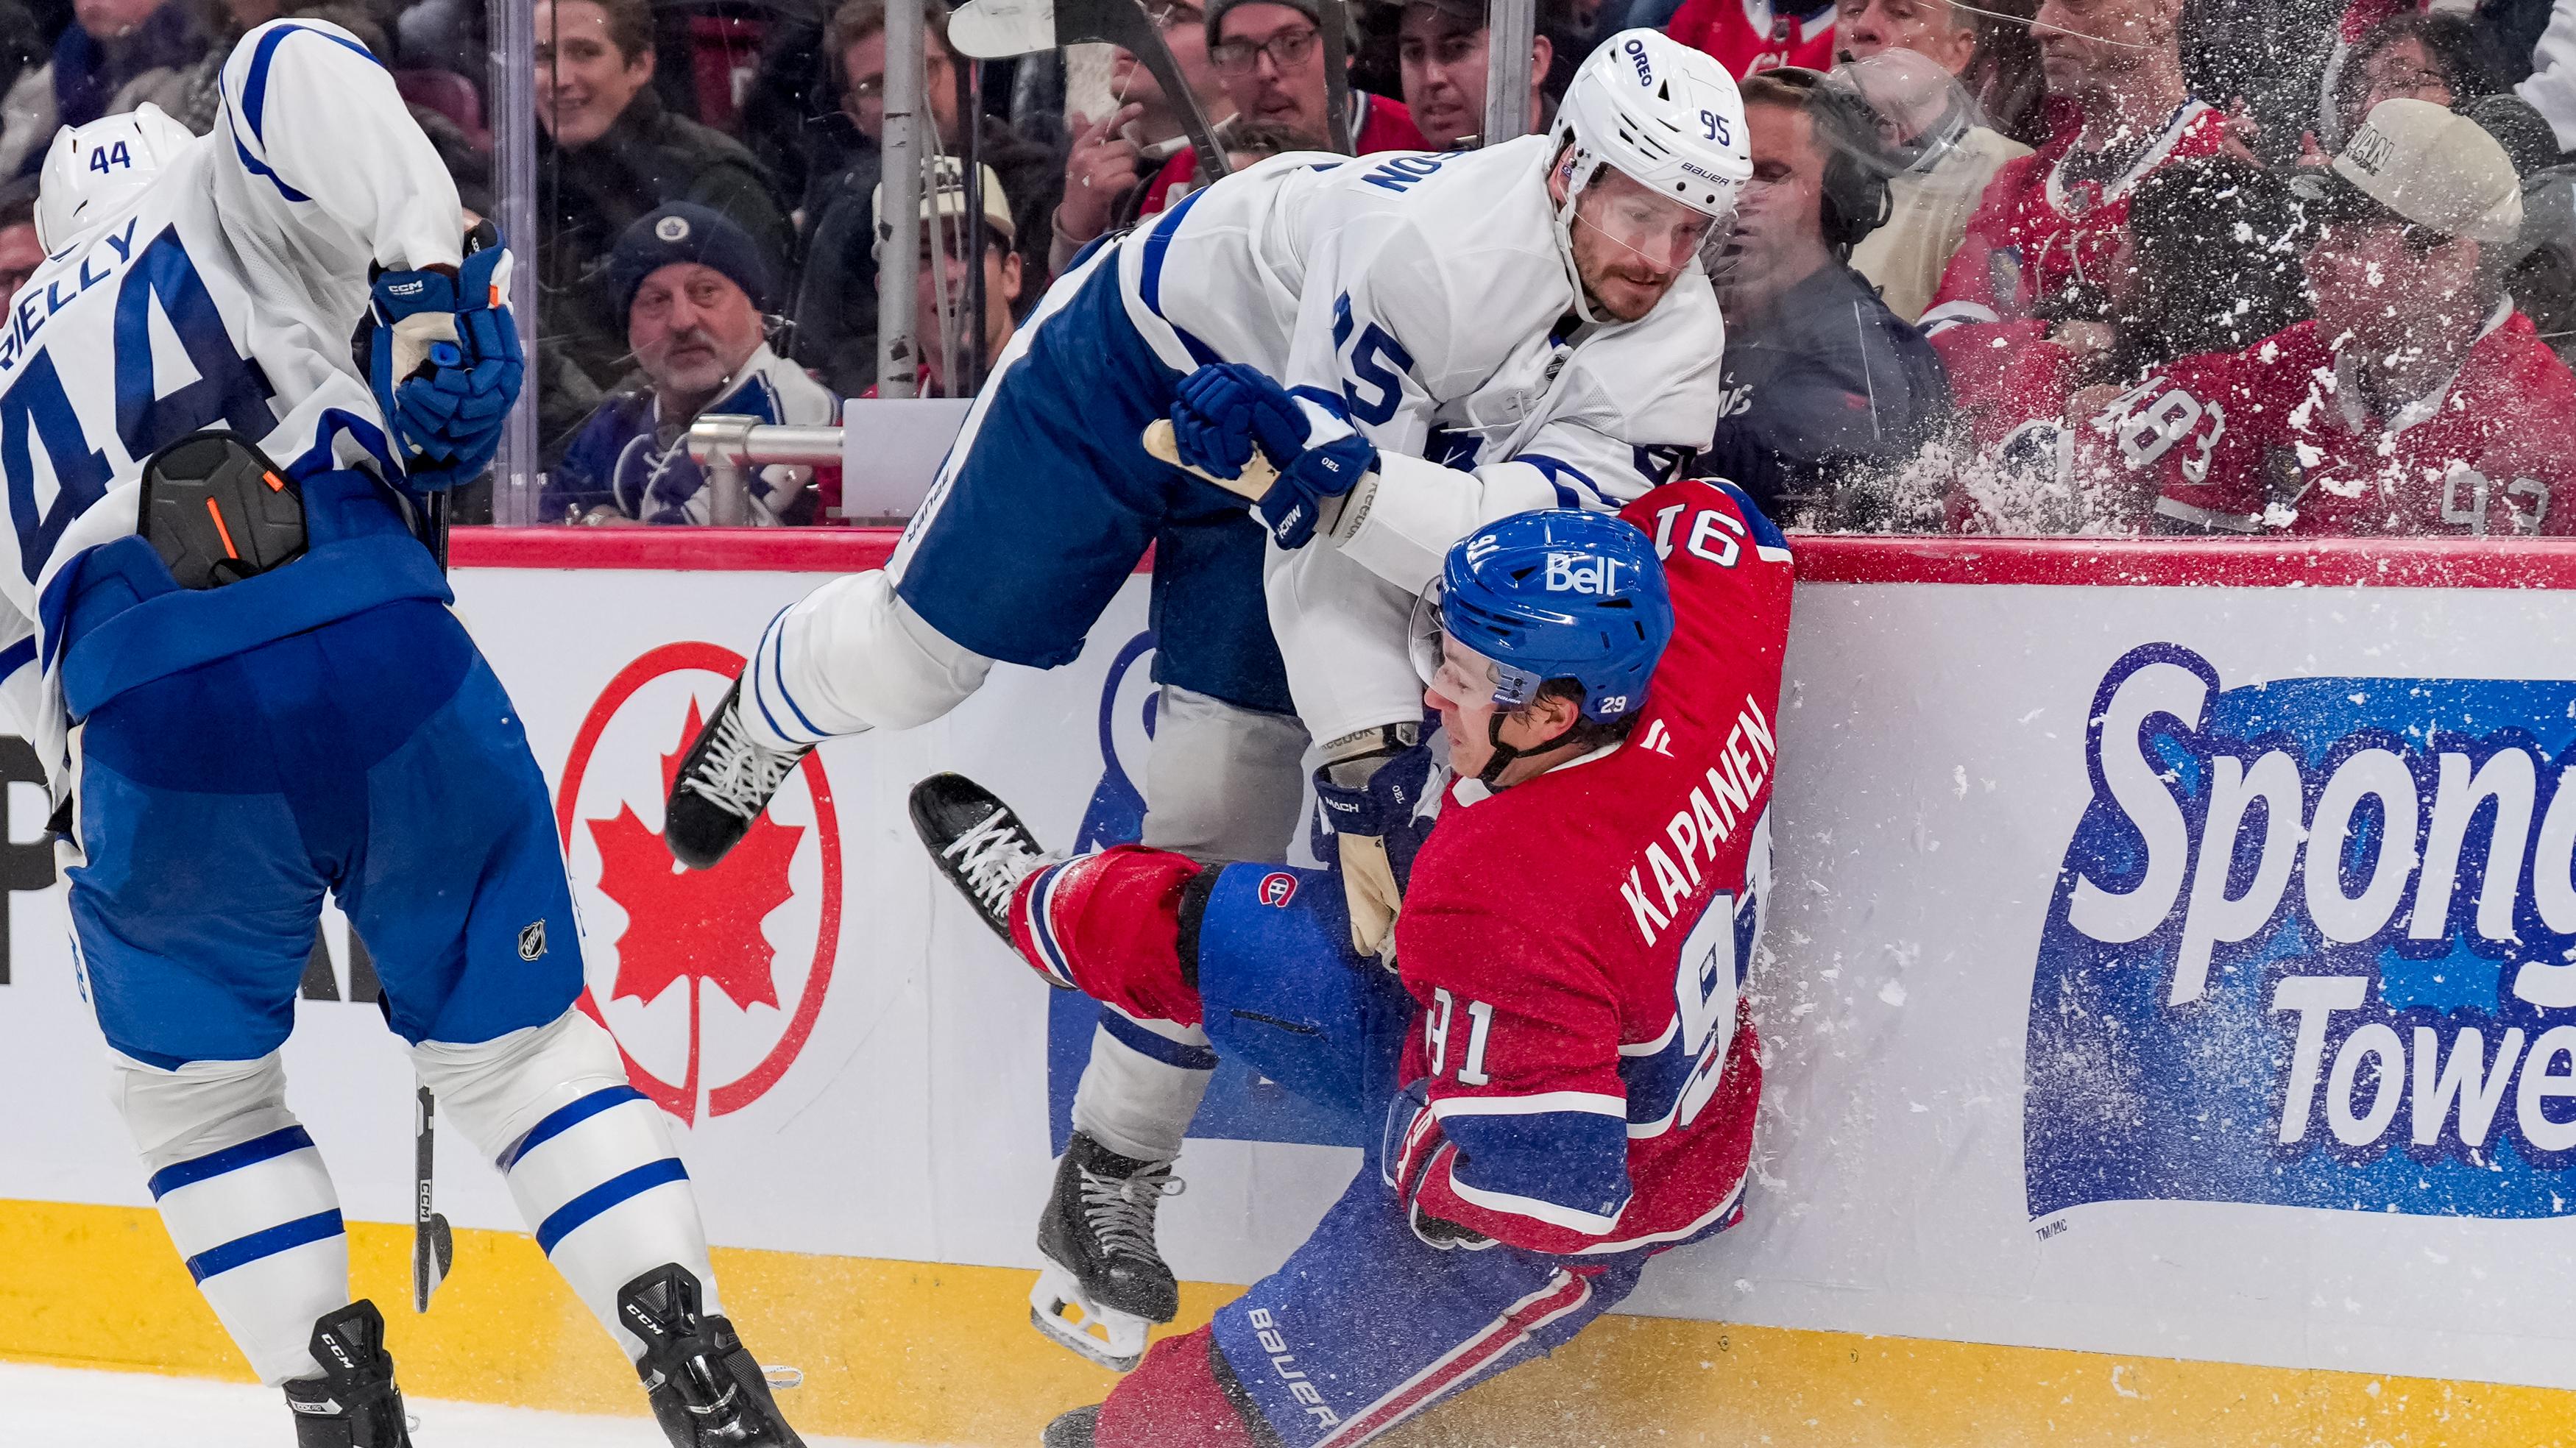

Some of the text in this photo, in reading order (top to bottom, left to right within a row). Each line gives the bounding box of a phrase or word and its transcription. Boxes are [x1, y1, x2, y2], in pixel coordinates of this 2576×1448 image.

[1624, 39, 1652, 87] OREO
[1700, 110, 1730, 147] 95
[90, 140, 131, 174] 44
[1681, 162, 1730, 187] BAUER
[389, 280, 423, 292] CCM
[0, 221, 280, 586] 44
[1546, 553, 1616, 595] Bell
[1600, 695, 1627, 714] 29
[1325, 796, 1359, 814] MACH
[1392, 785, 1406, 804] OEL
[1620, 693, 1776, 948] KAPANEN
[421, 1182, 431, 1219] CCM
[626, 1303, 664, 1336] CCM
[321, 1332, 355, 1369] CCM
[1248, 1307, 1341, 1430] BAUER
